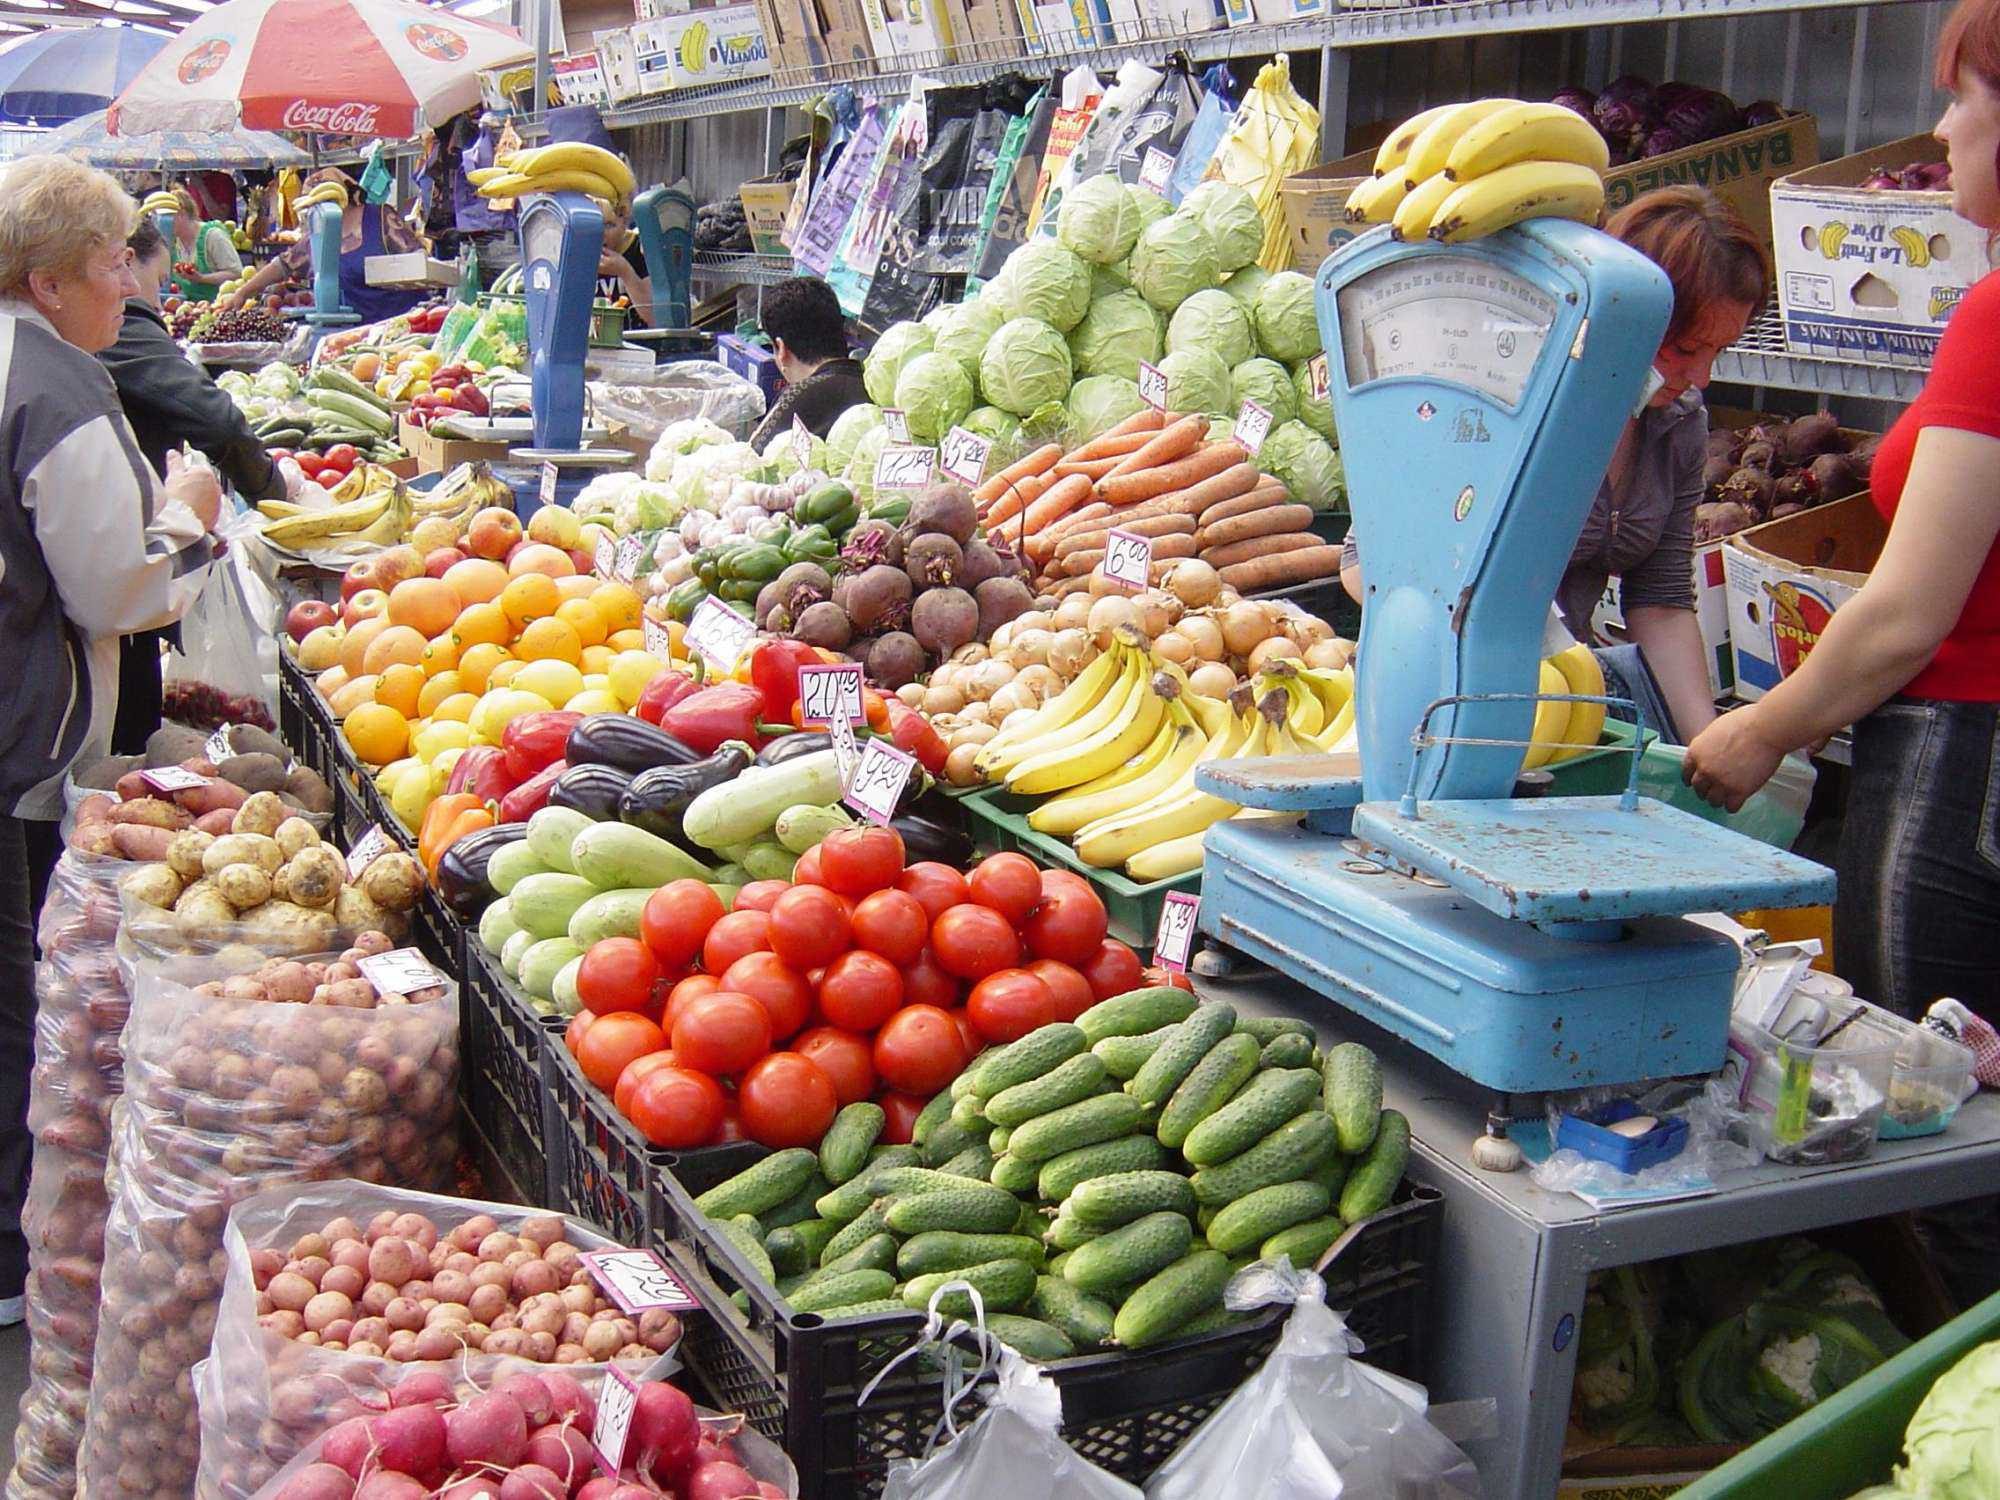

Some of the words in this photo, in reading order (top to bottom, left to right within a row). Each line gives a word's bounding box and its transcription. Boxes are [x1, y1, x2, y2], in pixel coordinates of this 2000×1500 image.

[283, 99, 381, 133] Coca-Cola
[1841, 243, 1876, 264] Fruit
[1880, 246, 1903, 265] Le
[1801, 323, 1878, 344] BANANAS
